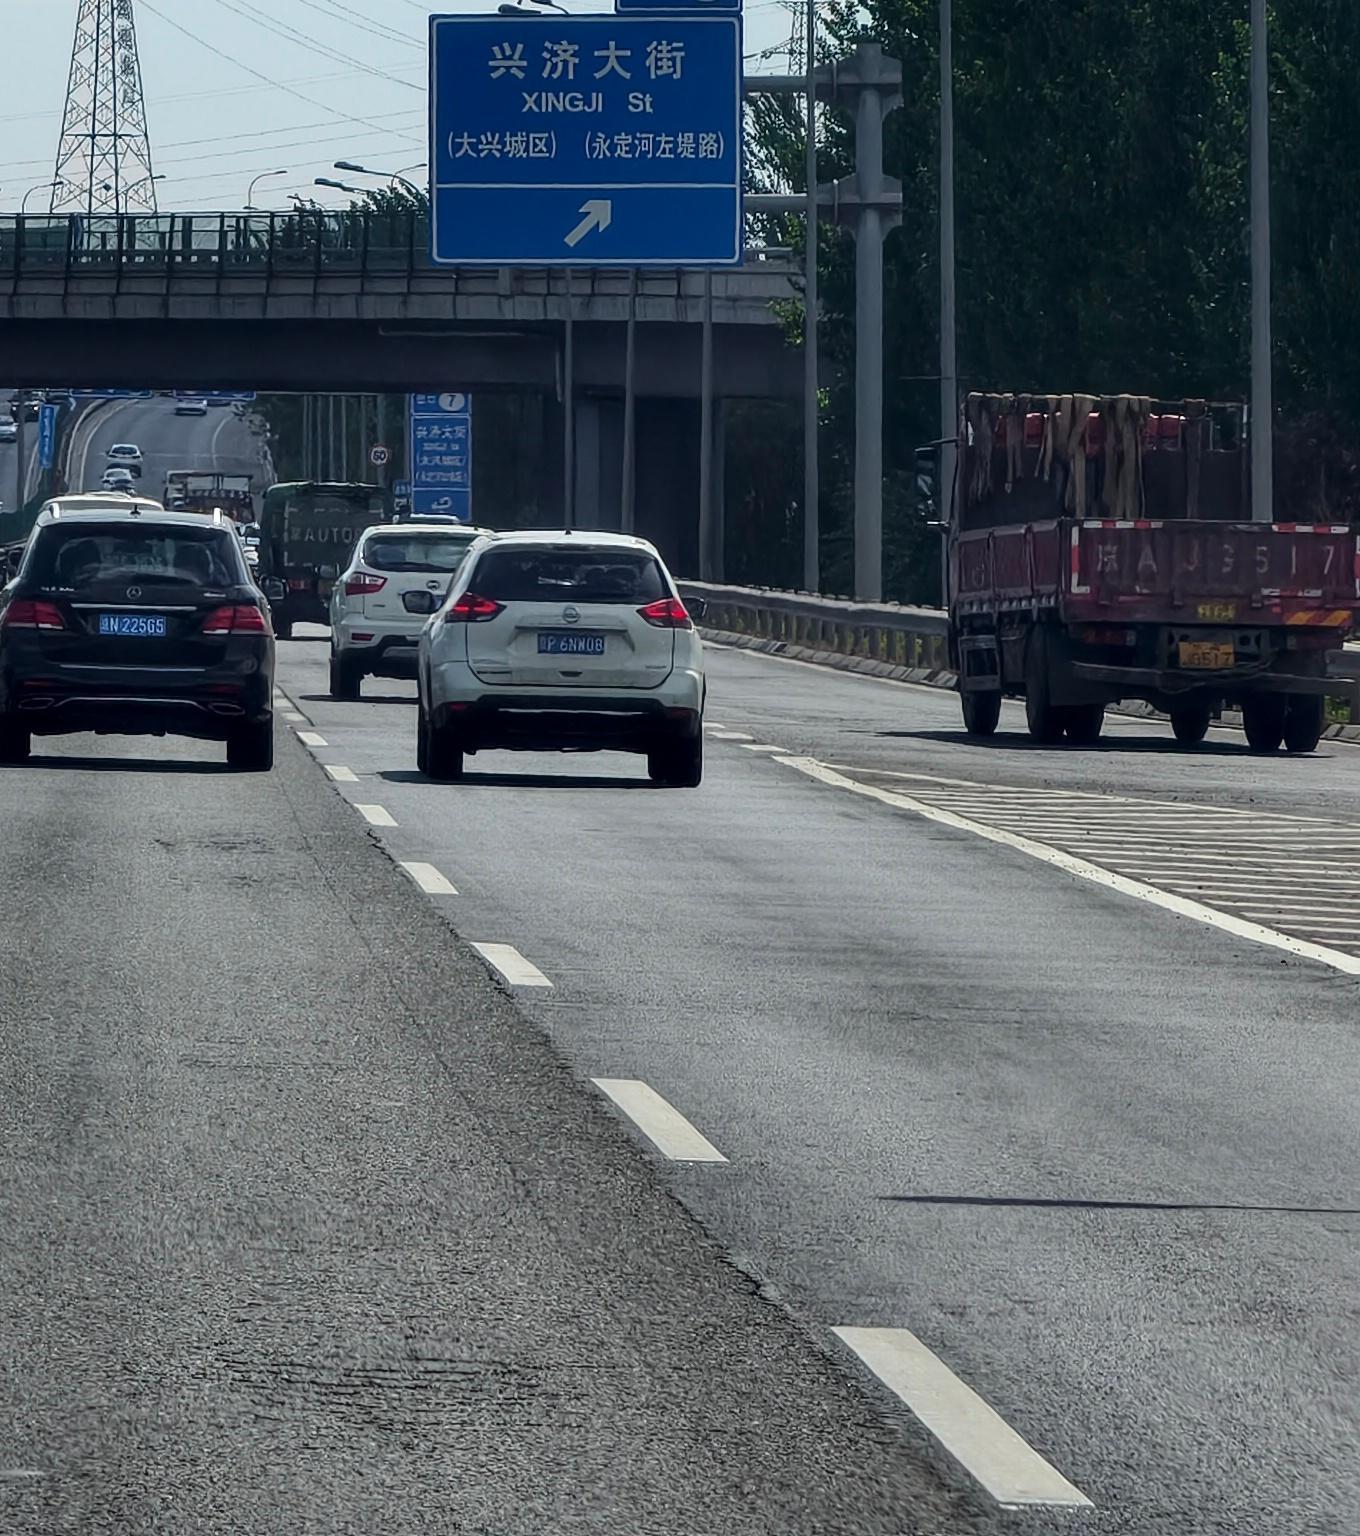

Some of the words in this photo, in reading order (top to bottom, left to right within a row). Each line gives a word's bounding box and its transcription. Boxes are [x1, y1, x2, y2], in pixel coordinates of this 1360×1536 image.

[488, 40, 685, 80] 兴济大街
[521, 92, 604, 114] XINGJI
[628, 92, 653, 114] St
[448, 131, 557, 159] (大兴城区)
[585, 131, 724, 159] (永定河左堤路)
[447, 394, 457, 408] 7
